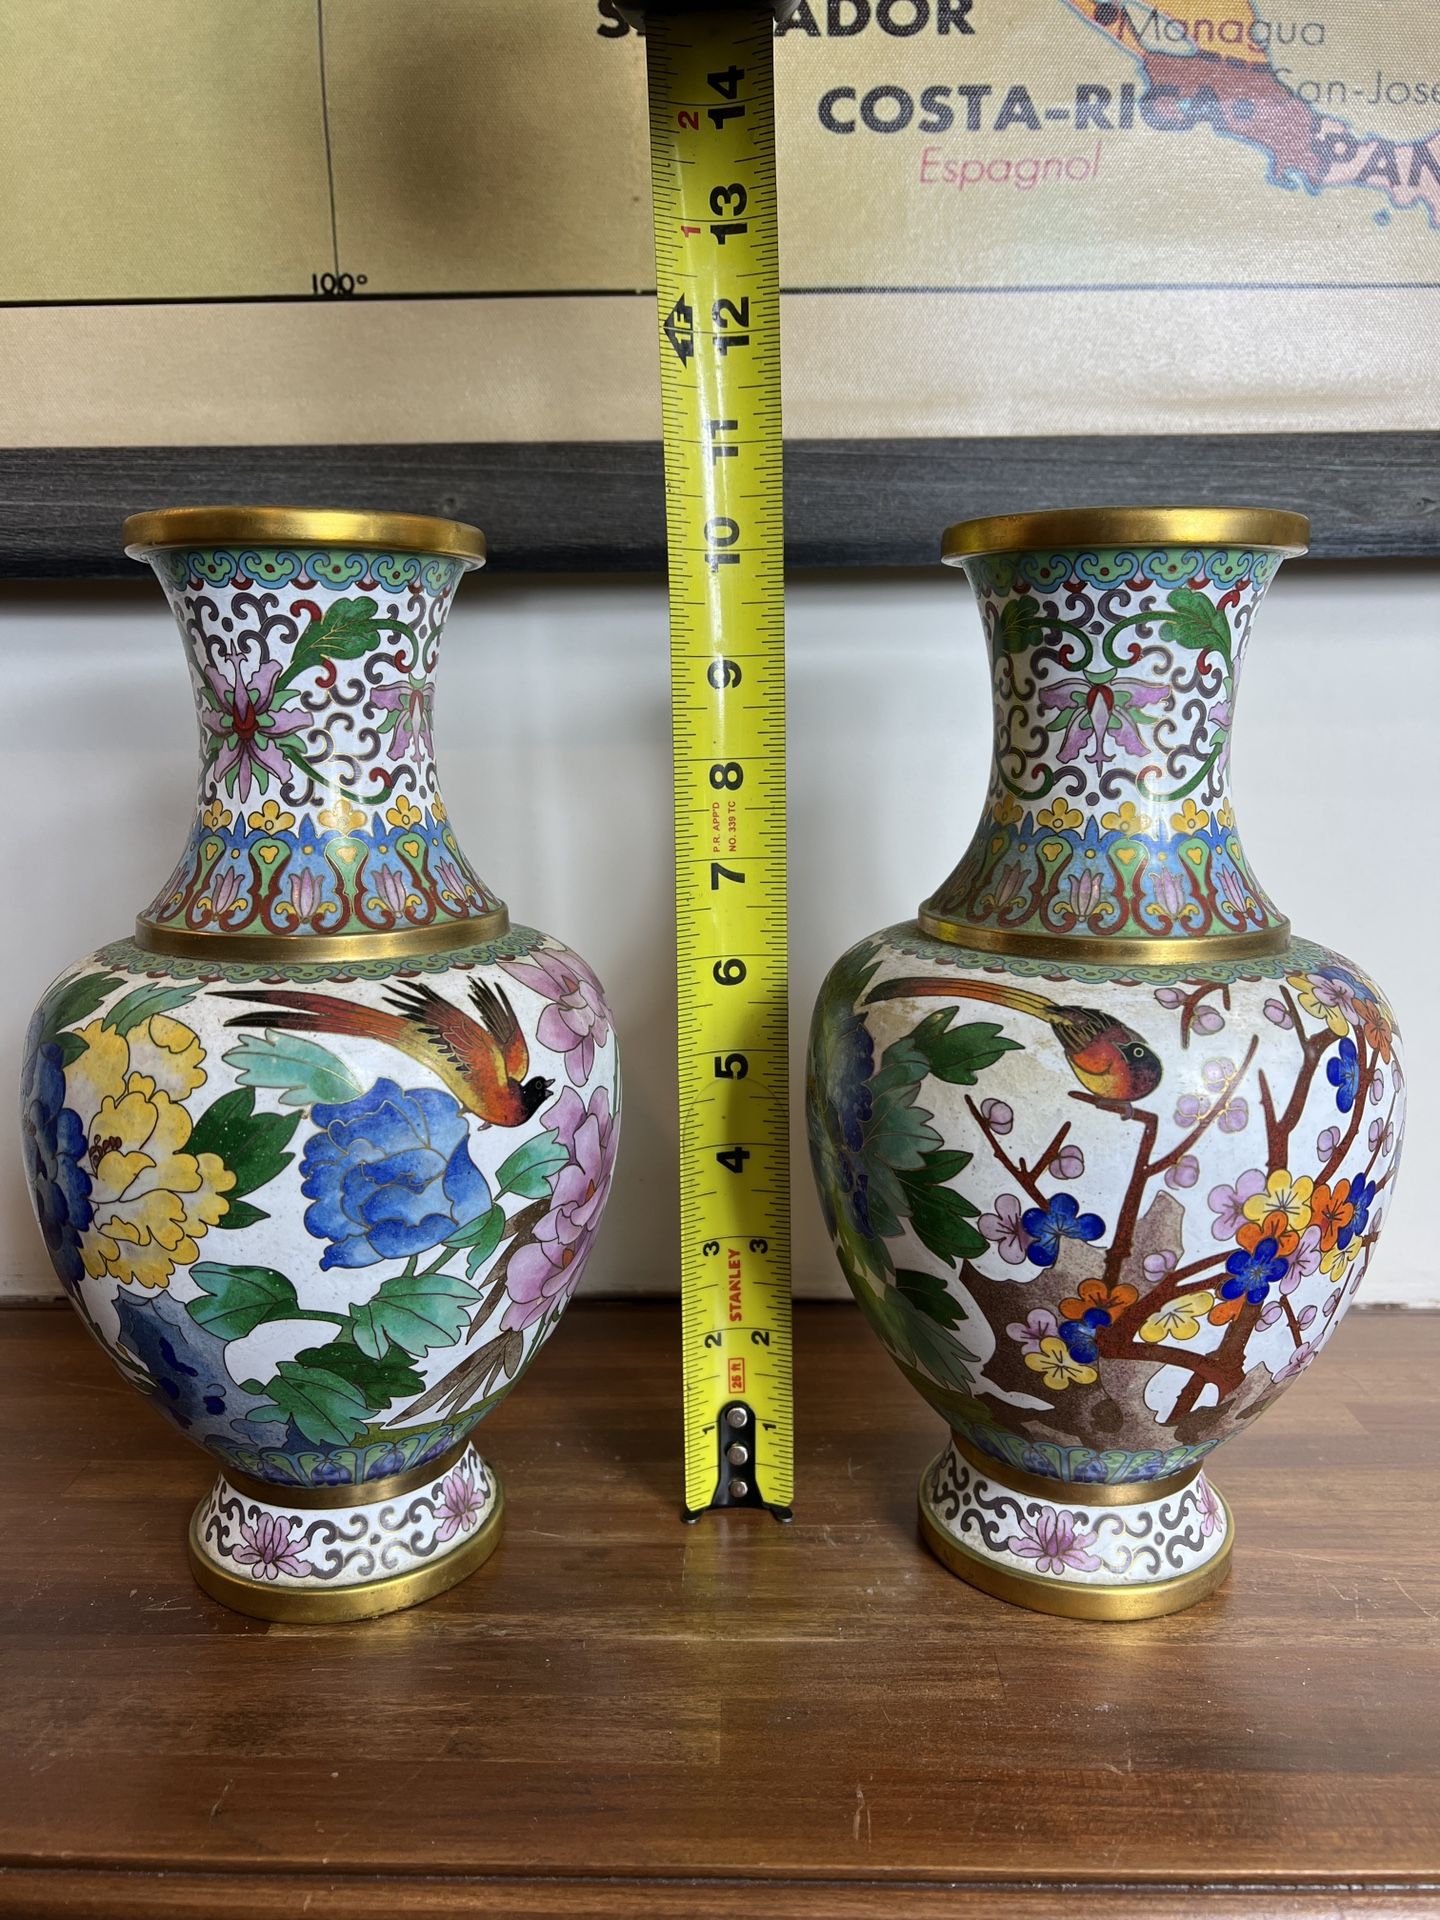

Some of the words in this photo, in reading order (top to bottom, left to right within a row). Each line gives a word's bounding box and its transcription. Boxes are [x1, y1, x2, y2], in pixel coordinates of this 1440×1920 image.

[1117, 5, 1325, 49] Managua
[707, 65, 746, 129] 14
[818, 83, 1229, 134] COSTA-RICA
[677, 110, 700, 130] 2
[920, 138, 1102, 192] Espagnol
[709, 183, 748, 245] 13
[711, 296, 750, 356] 12
[704, 516, 740, 573] 10
[707, 659, 743, 689] 9
[709, 761, 744, 791] 8
[728, 801, 736, 814] TC
[728, 816, 737, 832] 339
[728, 834, 737, 852] NO.
[711, 862, 745, 890] 7
[713, 958, 747, 986] 6
[714, 1053, 749, 1080] 5
[716, 1146, 750, 1173] 4
[702, 1240, 720, 1257] 3
[749, 1238, 768, 1254] 3
[728, 1248, 742, 1322] STANLEY
[704, 1332, 722, 1348] 2
[751, 1330, 770, 1346] 2
[702, 1425, 715, 1435] 1
[762, 1422, 777, 1431] 1
